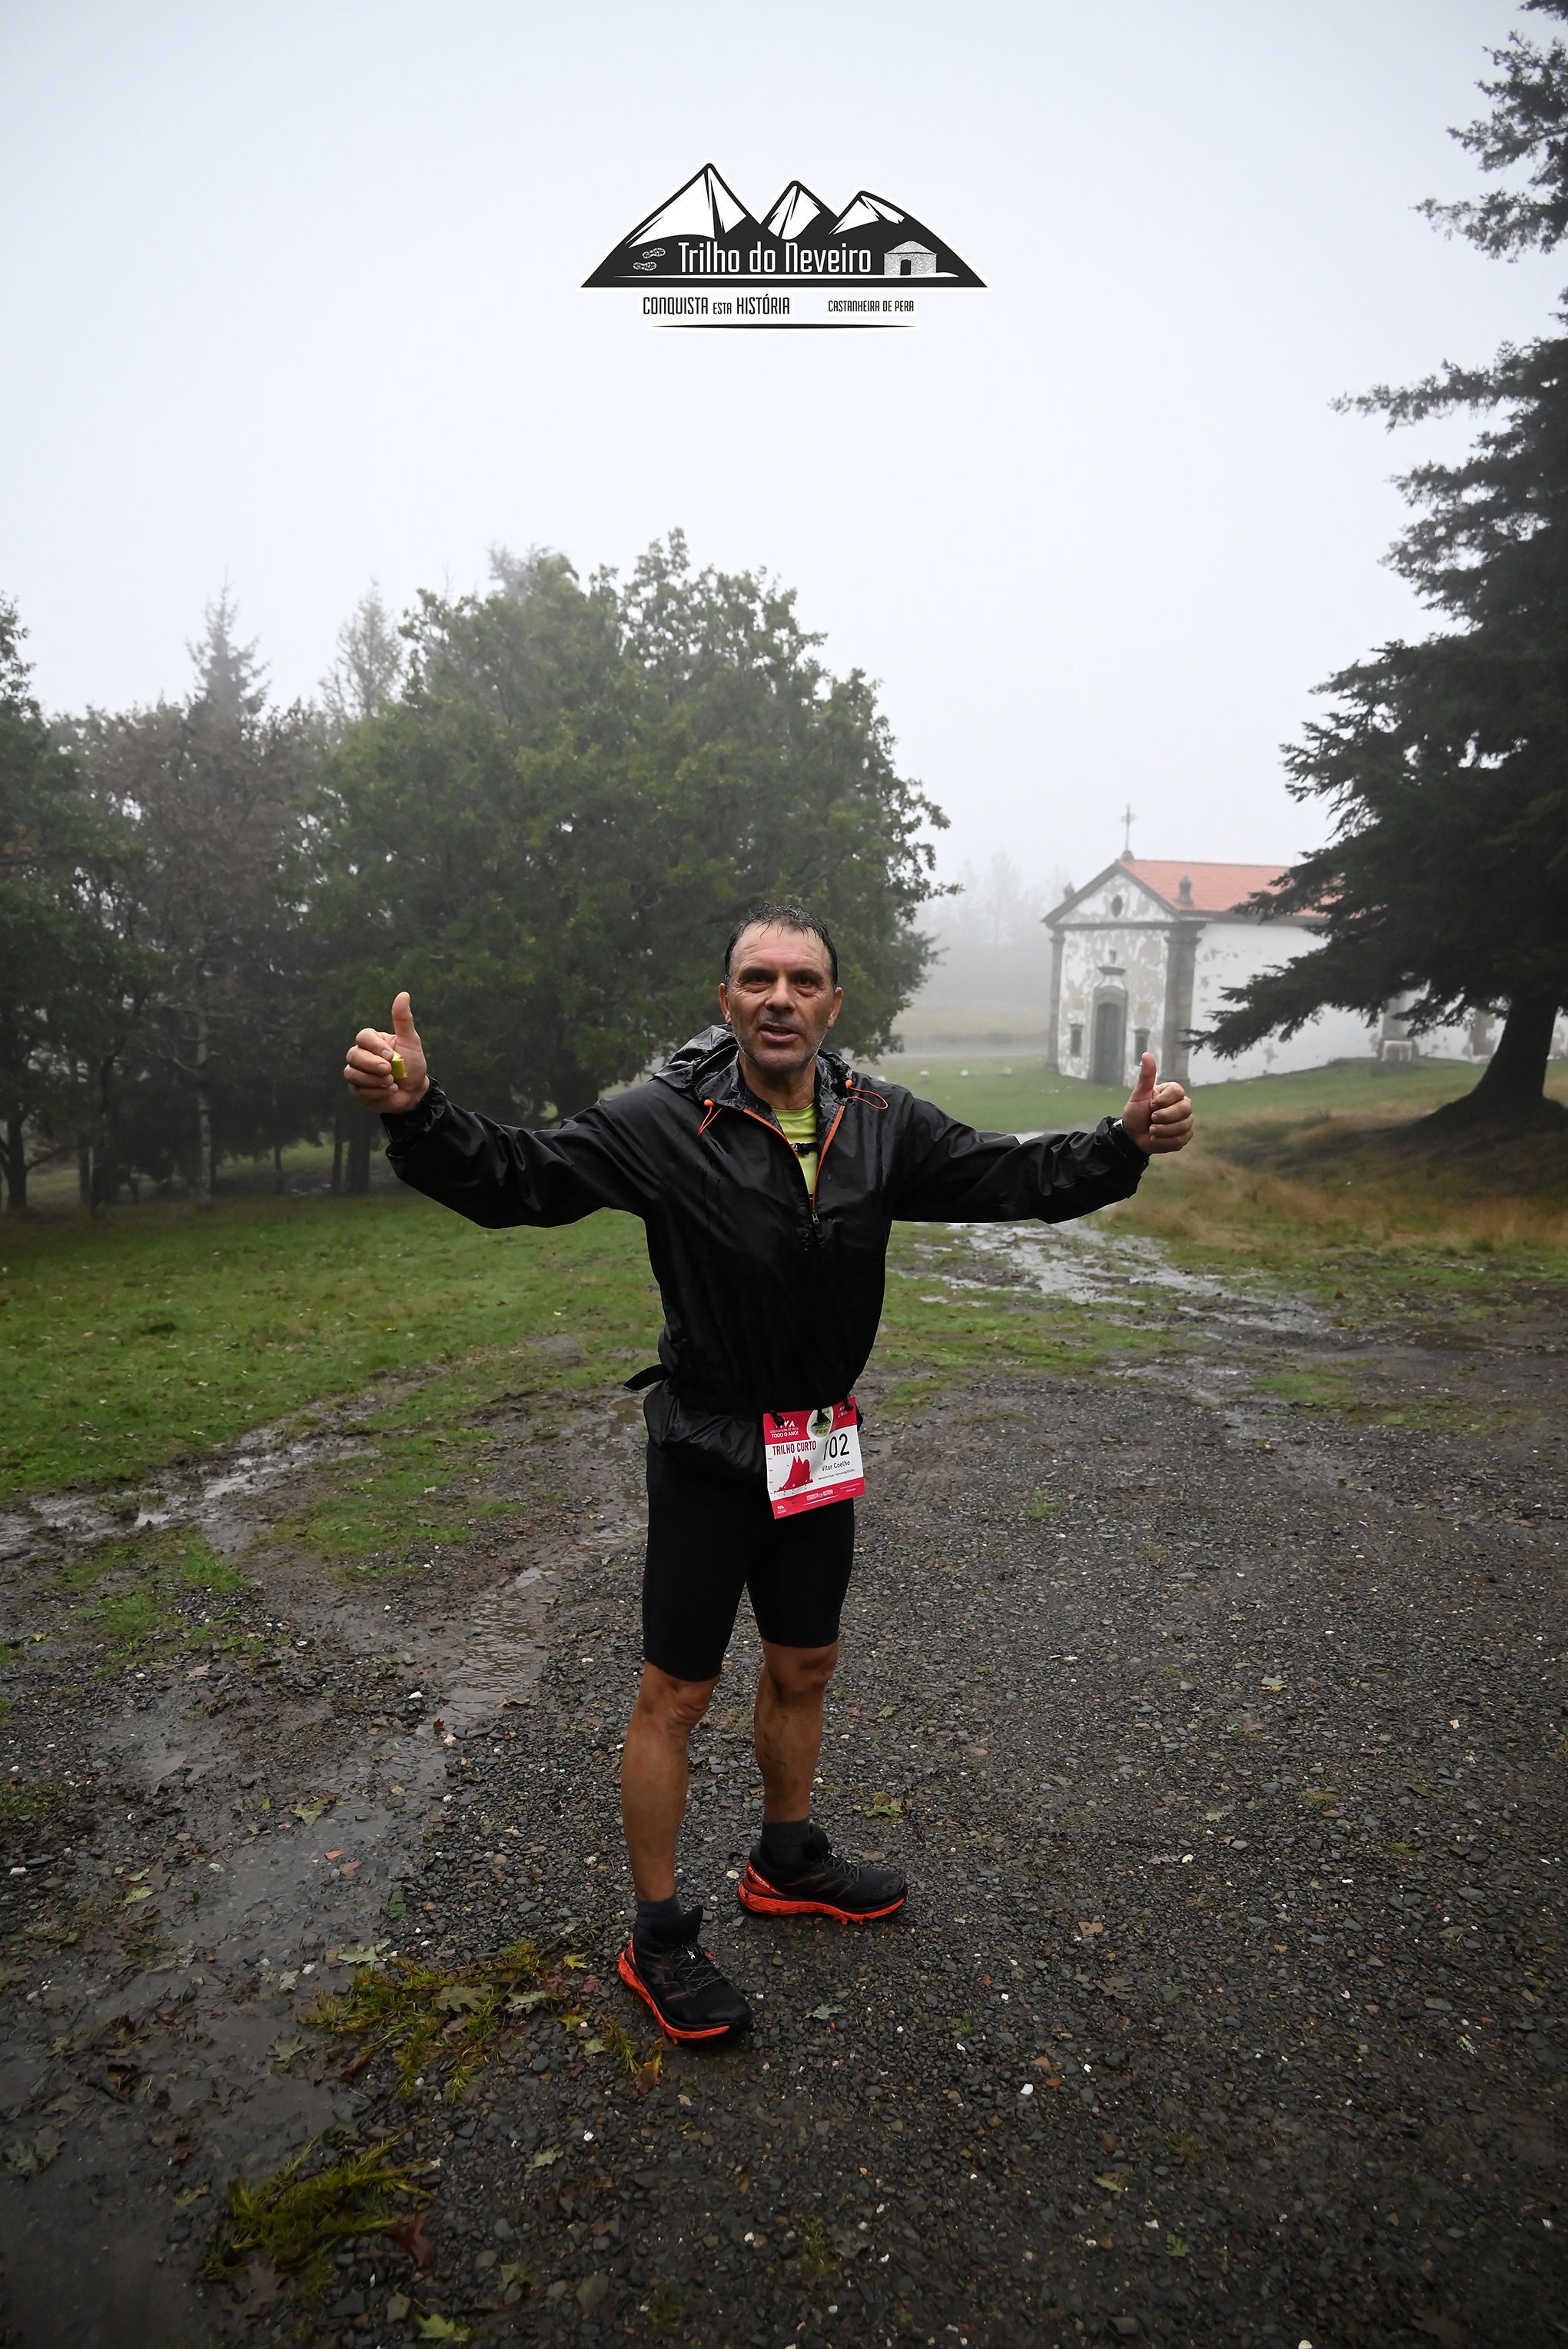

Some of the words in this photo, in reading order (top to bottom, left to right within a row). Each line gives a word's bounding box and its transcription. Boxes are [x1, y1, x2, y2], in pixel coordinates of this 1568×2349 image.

[772, 1443, 796, 1456] TRILHO
[796, 1440, 816, 1453] CURTO
[833, 1460, 851, 1469] Coelho
